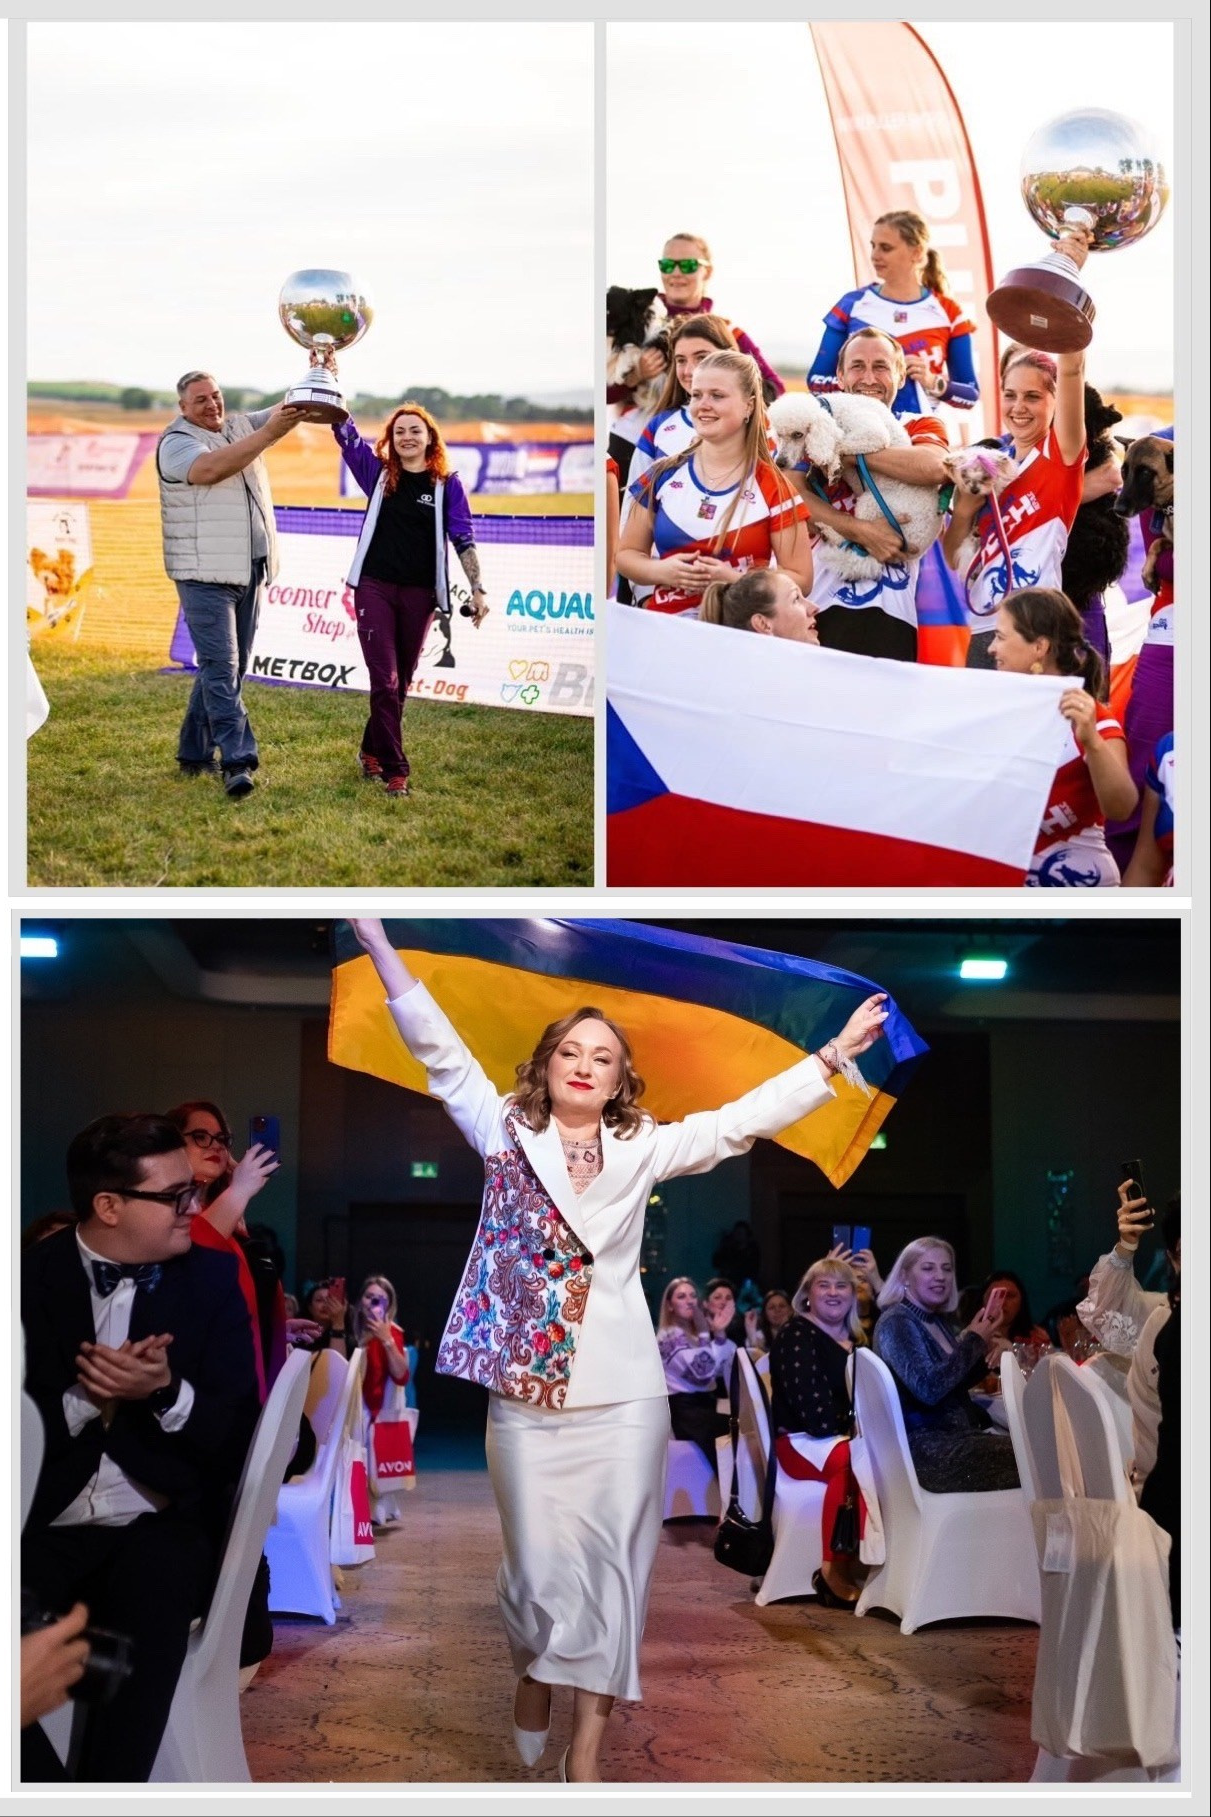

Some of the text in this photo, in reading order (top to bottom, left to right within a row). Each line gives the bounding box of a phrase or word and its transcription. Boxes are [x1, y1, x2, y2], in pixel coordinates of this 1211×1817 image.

[302, 612, 345, 642] Shop
[553, 626, 585, 635] HEALTH
[252, 655, 356, 688] METBOX
[377, 1460, 412, 1474] AVON
